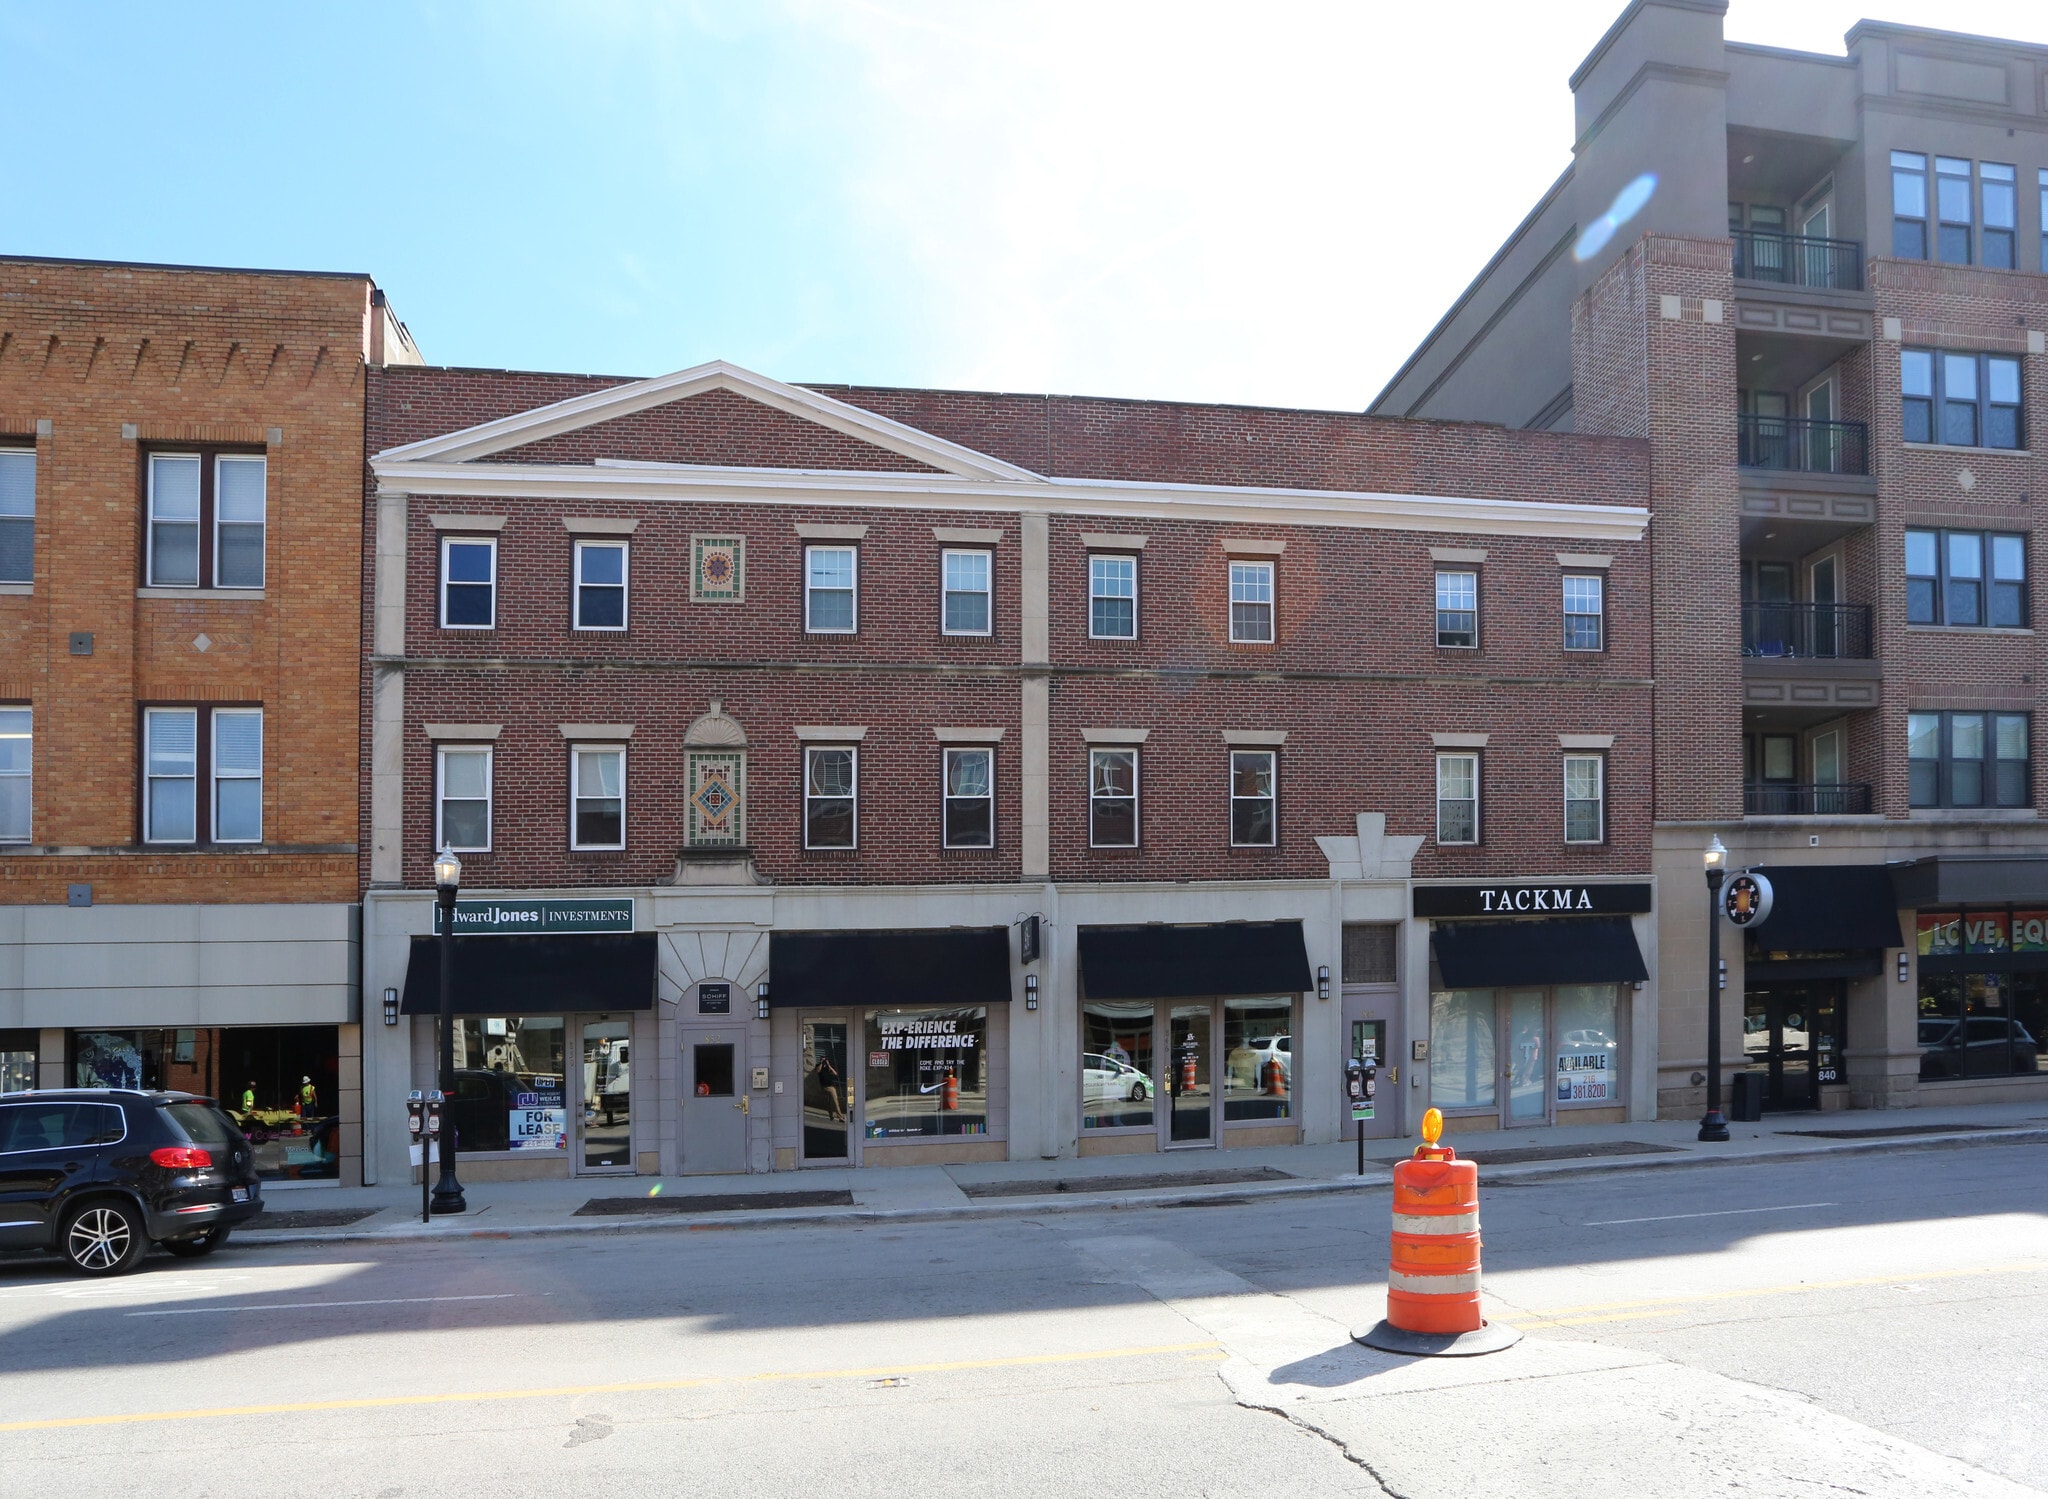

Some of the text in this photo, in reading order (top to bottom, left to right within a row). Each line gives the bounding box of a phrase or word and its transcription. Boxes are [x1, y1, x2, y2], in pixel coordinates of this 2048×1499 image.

[1480, 888, 1593, 911] TACKMA
[549, 910, 630, 922] INVESTMENTS
[1933, 919, 2048, 949] LOVE, EQ
[881, 1020, 957, 1035] EXP-ERIENCE
[881, 1034, 975, 1050] THE DIFFERENCE
[1558, 1054, 1606, 1071] AVAILABLE
[536, 1077, 555, 1087] OPEN
[1583, 1075, 1596, 1084] 216
[1818, 1070, 1837, 1081] 840
[1573, 1083, 1606, 1099] 381.8200
[526, 1110, 553, 1122] FOR
[518, 1123, 561, 1136] LEASE
